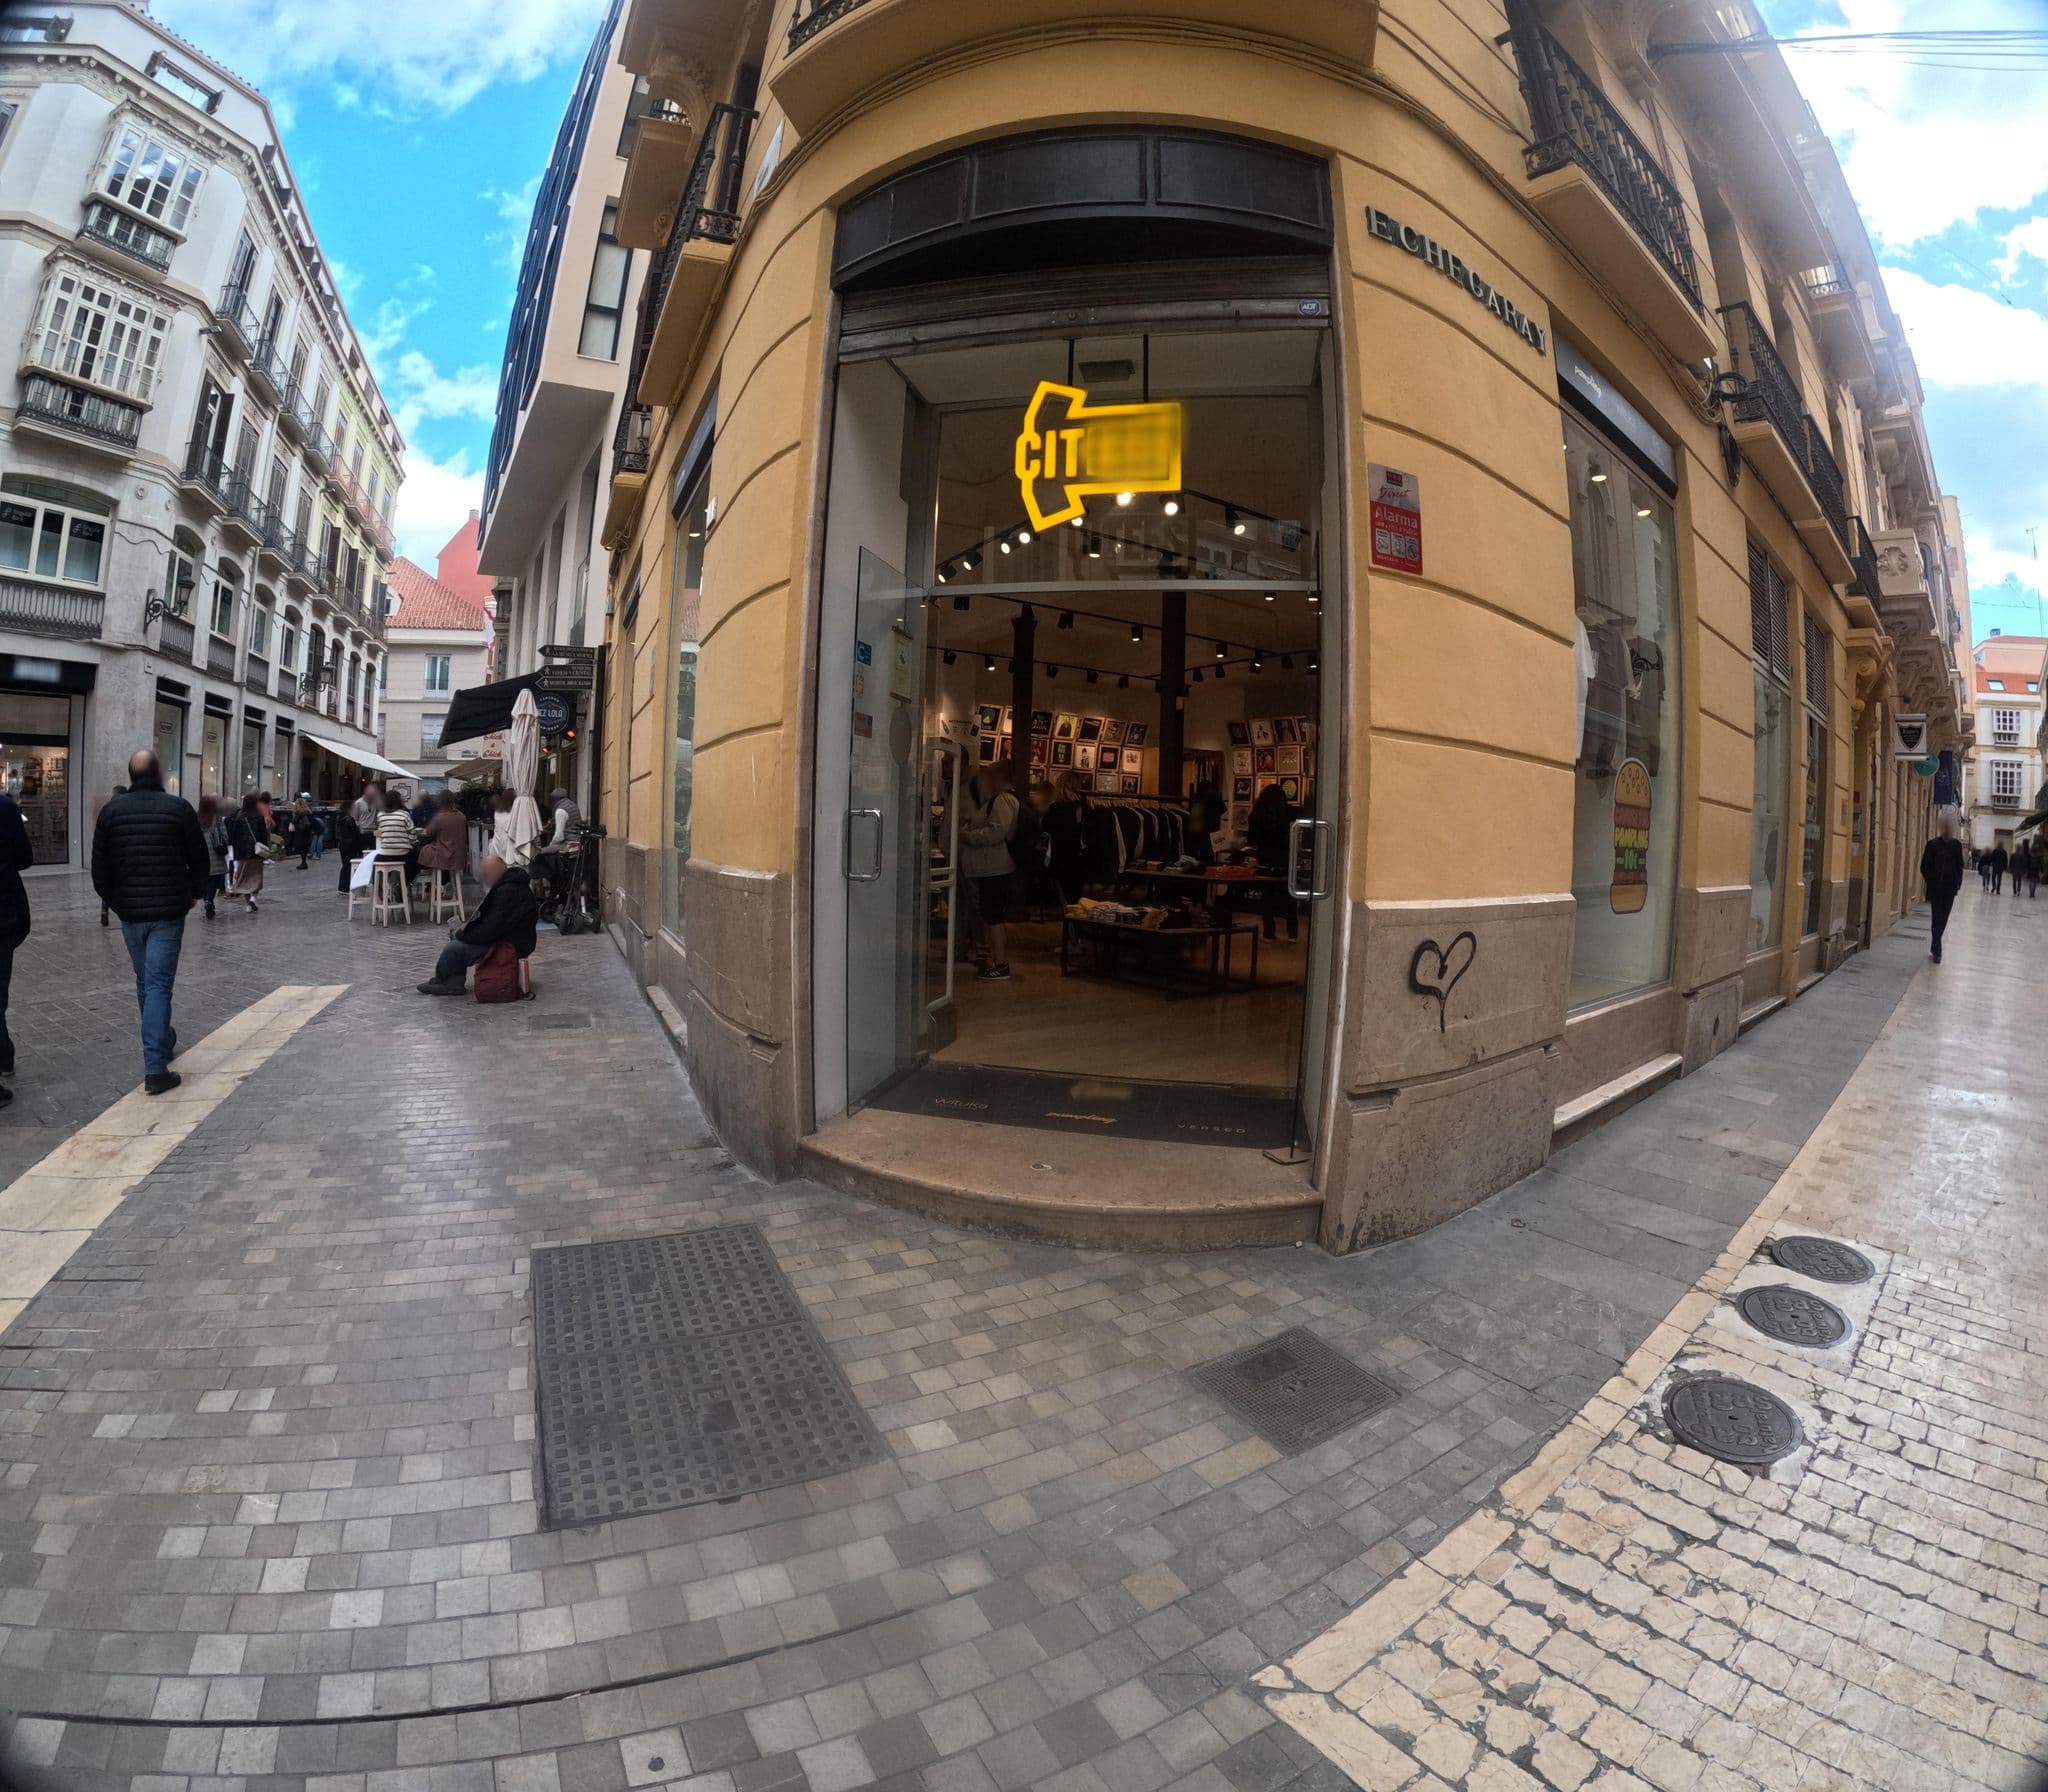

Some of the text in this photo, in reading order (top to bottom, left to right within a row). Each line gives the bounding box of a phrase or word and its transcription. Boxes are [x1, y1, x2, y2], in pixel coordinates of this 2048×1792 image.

[1365, 206, 1546, 355] ECHEGARAY
[1375, 507, 1418, 529] Alarma
[547, 709, 563, 718] LOLA
